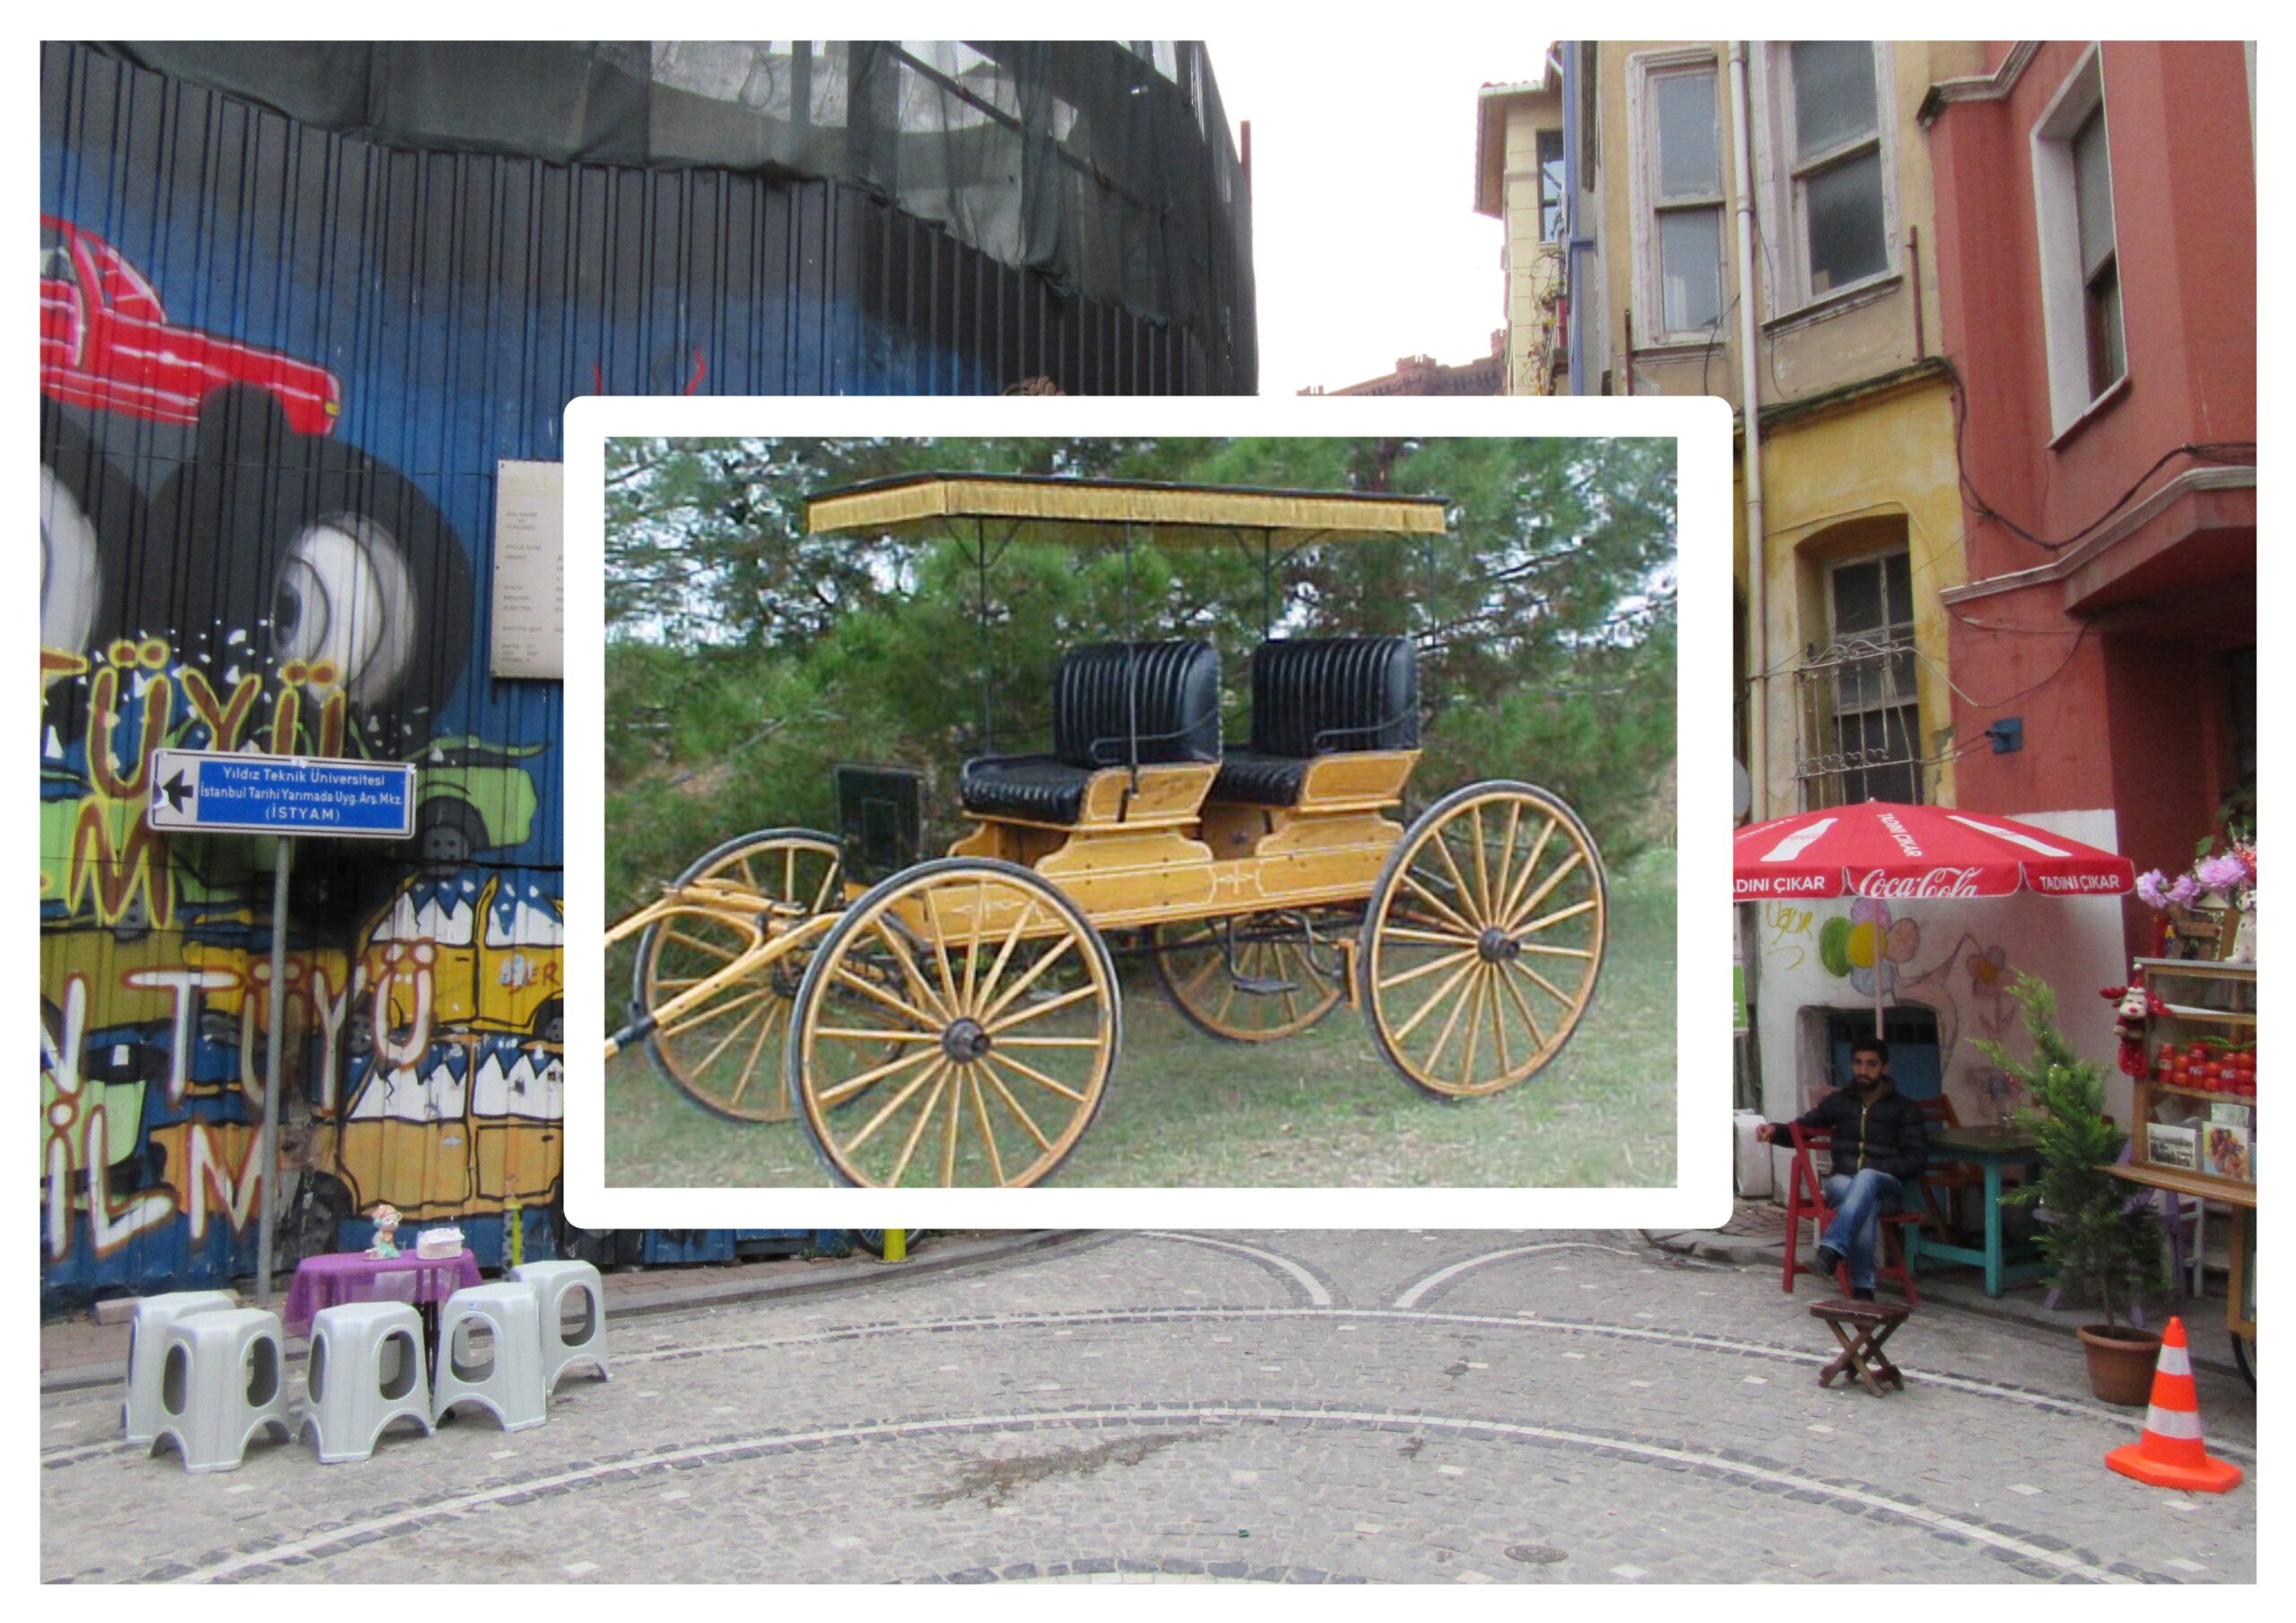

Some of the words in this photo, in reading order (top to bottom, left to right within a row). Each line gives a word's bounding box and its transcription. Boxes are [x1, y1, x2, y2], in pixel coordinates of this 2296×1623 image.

[223, 767, 260, 780] Yıldız
[263, 768, 306, 783] Teknik
[310, 768, 385, 786] Üniversitesi
[200, 781, 247, 799] İstanbul
[248, 785, 280, 801] Tarihi
[282, 788, 334, 803] Yarımada
[335, 790, 358, 806] Uyg.
[379, 793, 403, 805] Mkz.
[265, 803, 341, 823] (İSTYAM)
[1772, 875, 1825, 895] ÇIKAR
[1858, 867, 1984, 897] Coca-Cola
[2039, 875, 2078, 891] TADINI
[2080, 874, 2120, 892] ÇIKAR
